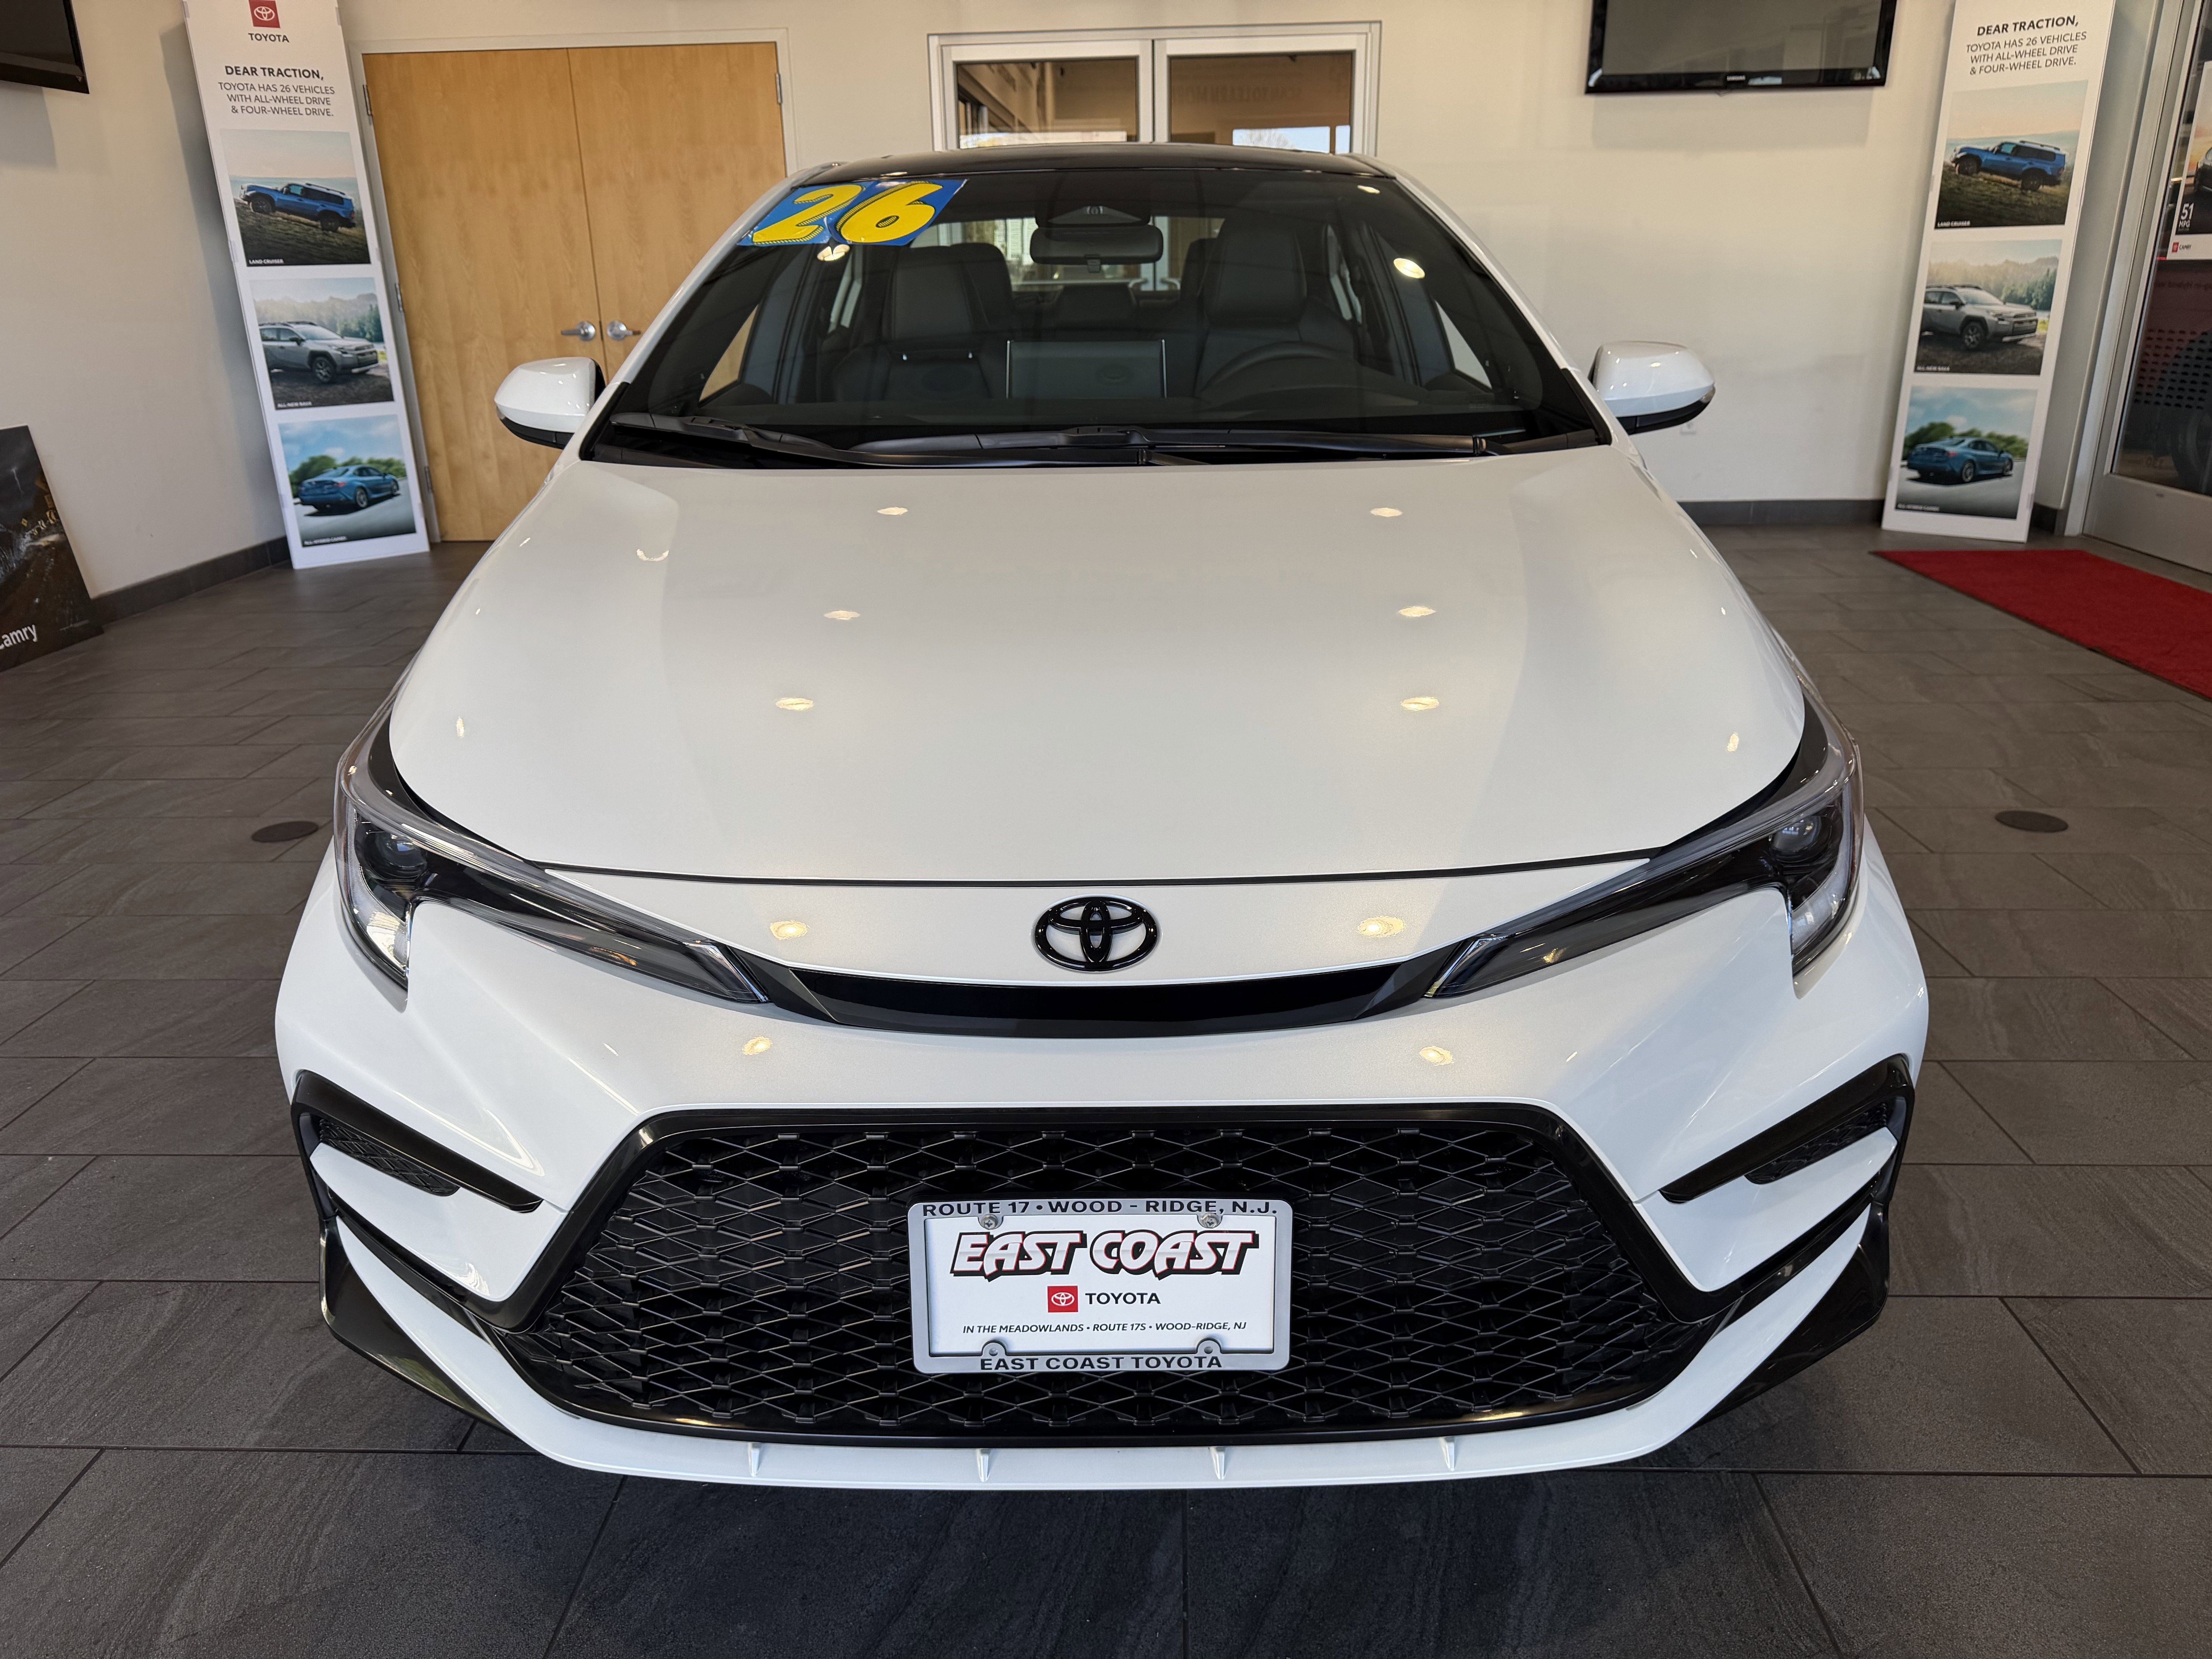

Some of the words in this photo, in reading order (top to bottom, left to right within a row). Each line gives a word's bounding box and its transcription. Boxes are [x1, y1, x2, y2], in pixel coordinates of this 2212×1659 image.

[1977, 23, 2009, 36] DEAR
[2012, 15, 2079, 32] TRACTION,
[248, 33, 290, 43] TOYOTA
[1966, 41, 2001, 53] TOYOTA
[2004, 38, 2023, 48] HAS
[2026, 37, 2037, 46] 26
[2040, 31, 2087, 44] VEHICLES
[1970, 53, 1993, 64] WITH
[1995, 48, 2047, 60] ALL-WHEEL
[2049, 44, 2078, 55] DRIVE
[225, 65, 259, 76] DEAR
[260, 67, 324, 81] TRACTION,
[1970, 66, 1976, 75] &
[1979, 60, 2042, 74] FOUR-WHEEL
[2045, 56, 2076, 67] DRIVE.
[218, 82, 256, 92] TOYOTA
[258, 84, 277, 92] HAS
[280, 84, 291, 93] 26
[292, 85, 335, 94] VEHICLES
[227, 94, 251, 102] WITH
[254, 95, 304, 104] ALL-WHEEL
[306, 96, 331, 105] DRIVE
[240, 106, 303, 115] FOUR-WHEEL
[305, 108, 334, 116] DRIVE.
[752, 181, 943, 244] 26
[2181, 203, 2194, 220] 51
[0, 624, 38, 649] amry
[923, 1202, 1001, 1216] ROUTE
[1008, 1202, 1030, 1213] 17
[1048, 1200, 1122, 1213] WOOD
[1146, 1200, 1224, 1214] RIDGE,
[1232, 1201, 1277, 1214] N.J.
[950, 1230, 1087, 1282] EAST
[1089, 1229, 1259, 1281] COAST
[1085, 1292, 1161, 1305] TOYOTA
[999, 1324, 1084, 1333] MEADOWLANDS
[1155, 1322, 1231, 1331] WOOD-RIDGE,
[981, 1358, 1039, 1370] EAST
[1046, 1357, 1124, 1369] COAST
[1131, 1356, 1222, 1369] TOYOTA
